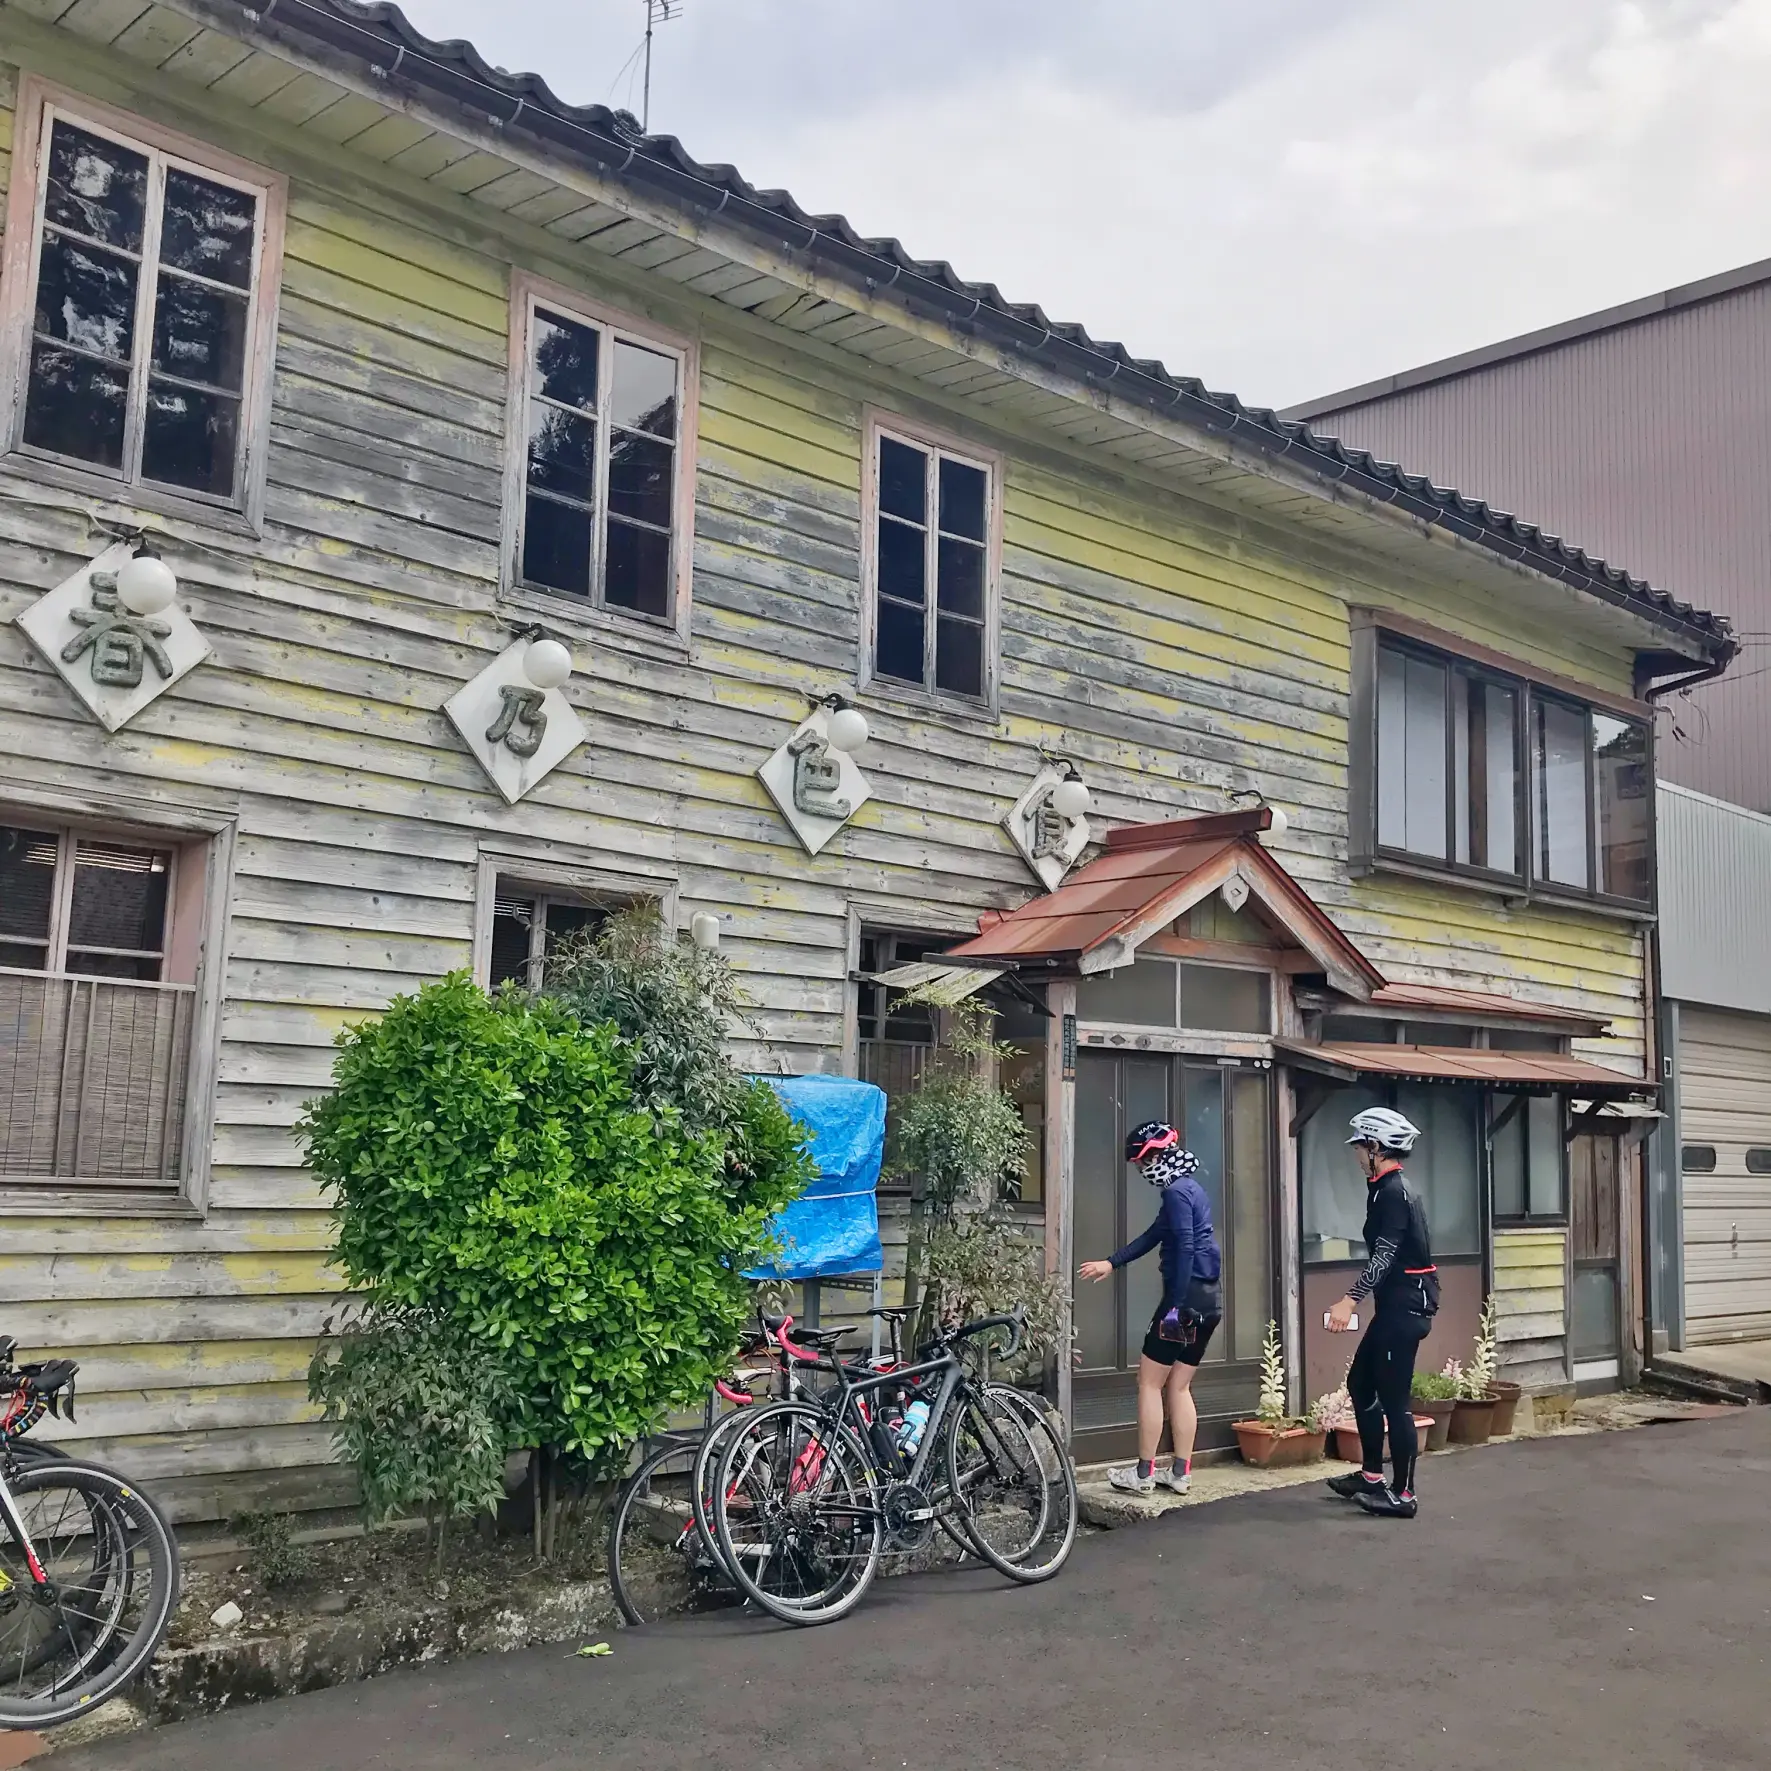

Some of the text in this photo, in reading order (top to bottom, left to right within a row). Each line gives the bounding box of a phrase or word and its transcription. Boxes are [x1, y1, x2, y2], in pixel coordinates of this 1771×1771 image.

[60, 569, 174, 689] 春
[485, 684, 548, 759] 乃
[787, 728, 852, 821] 色
